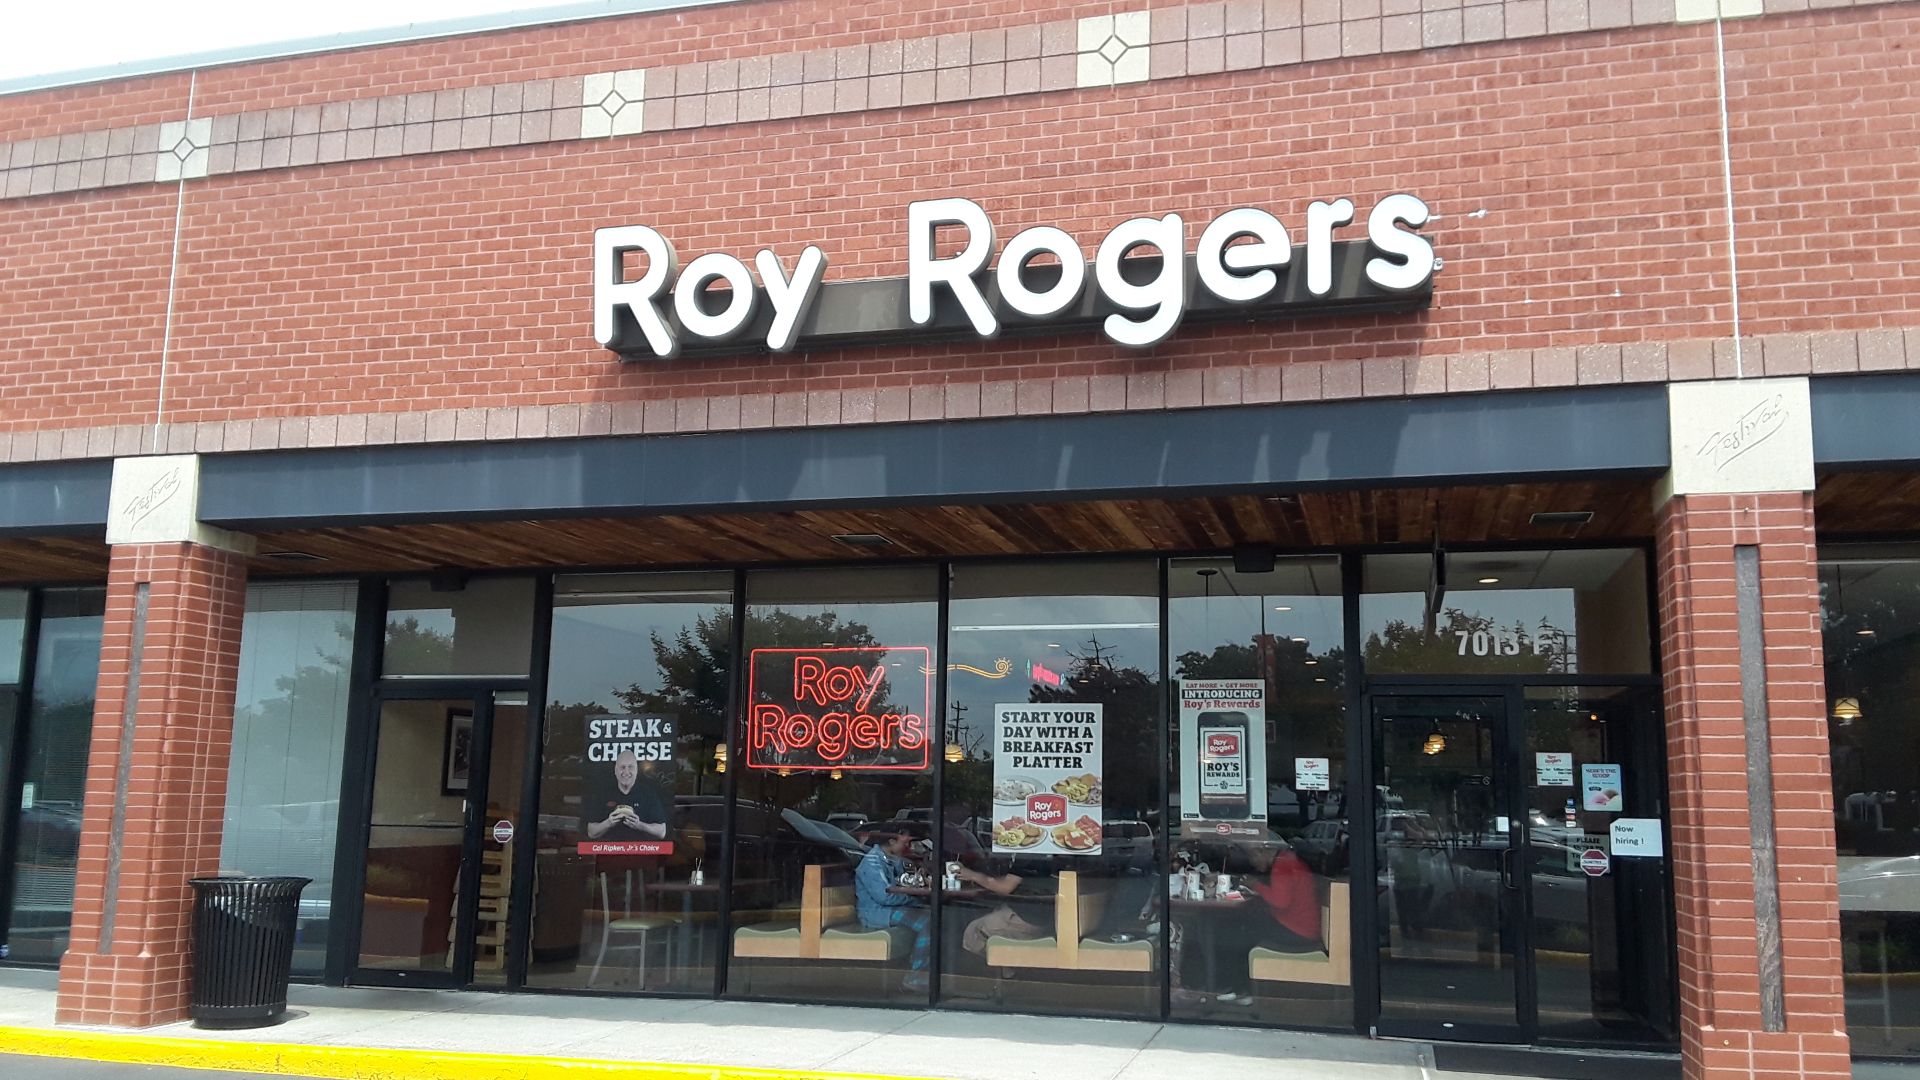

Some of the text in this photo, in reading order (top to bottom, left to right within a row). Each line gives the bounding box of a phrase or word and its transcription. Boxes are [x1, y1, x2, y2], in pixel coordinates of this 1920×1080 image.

[594, 193, 1435, 356] Roy Rogers
[1455, 630, 1520, 656] 7013
[794, 656, 884, 712] Roy
[1184, 690, 1260, 698] INTRODUCING
[1184, 700, 1260, 710] Roy's Rewards
[1001, 711, 1096, 723] START YOUR
[589, 718, 672, 739] STEAK &
[754, 704, 923, 760] Rogers
[1003, 726, 1094, 739] DAY WITH A
[1003, 741, 1094, 753] BREAKFAST
[1013, 756, 1083, 768] PLATTER
[1207, 762, 1239, 771] ROY'S
[1034, 801, 1052, 811] Roy
[1030, 809, 1062, 820] Rogers
[1616, 838, 1639, 846] hiring
